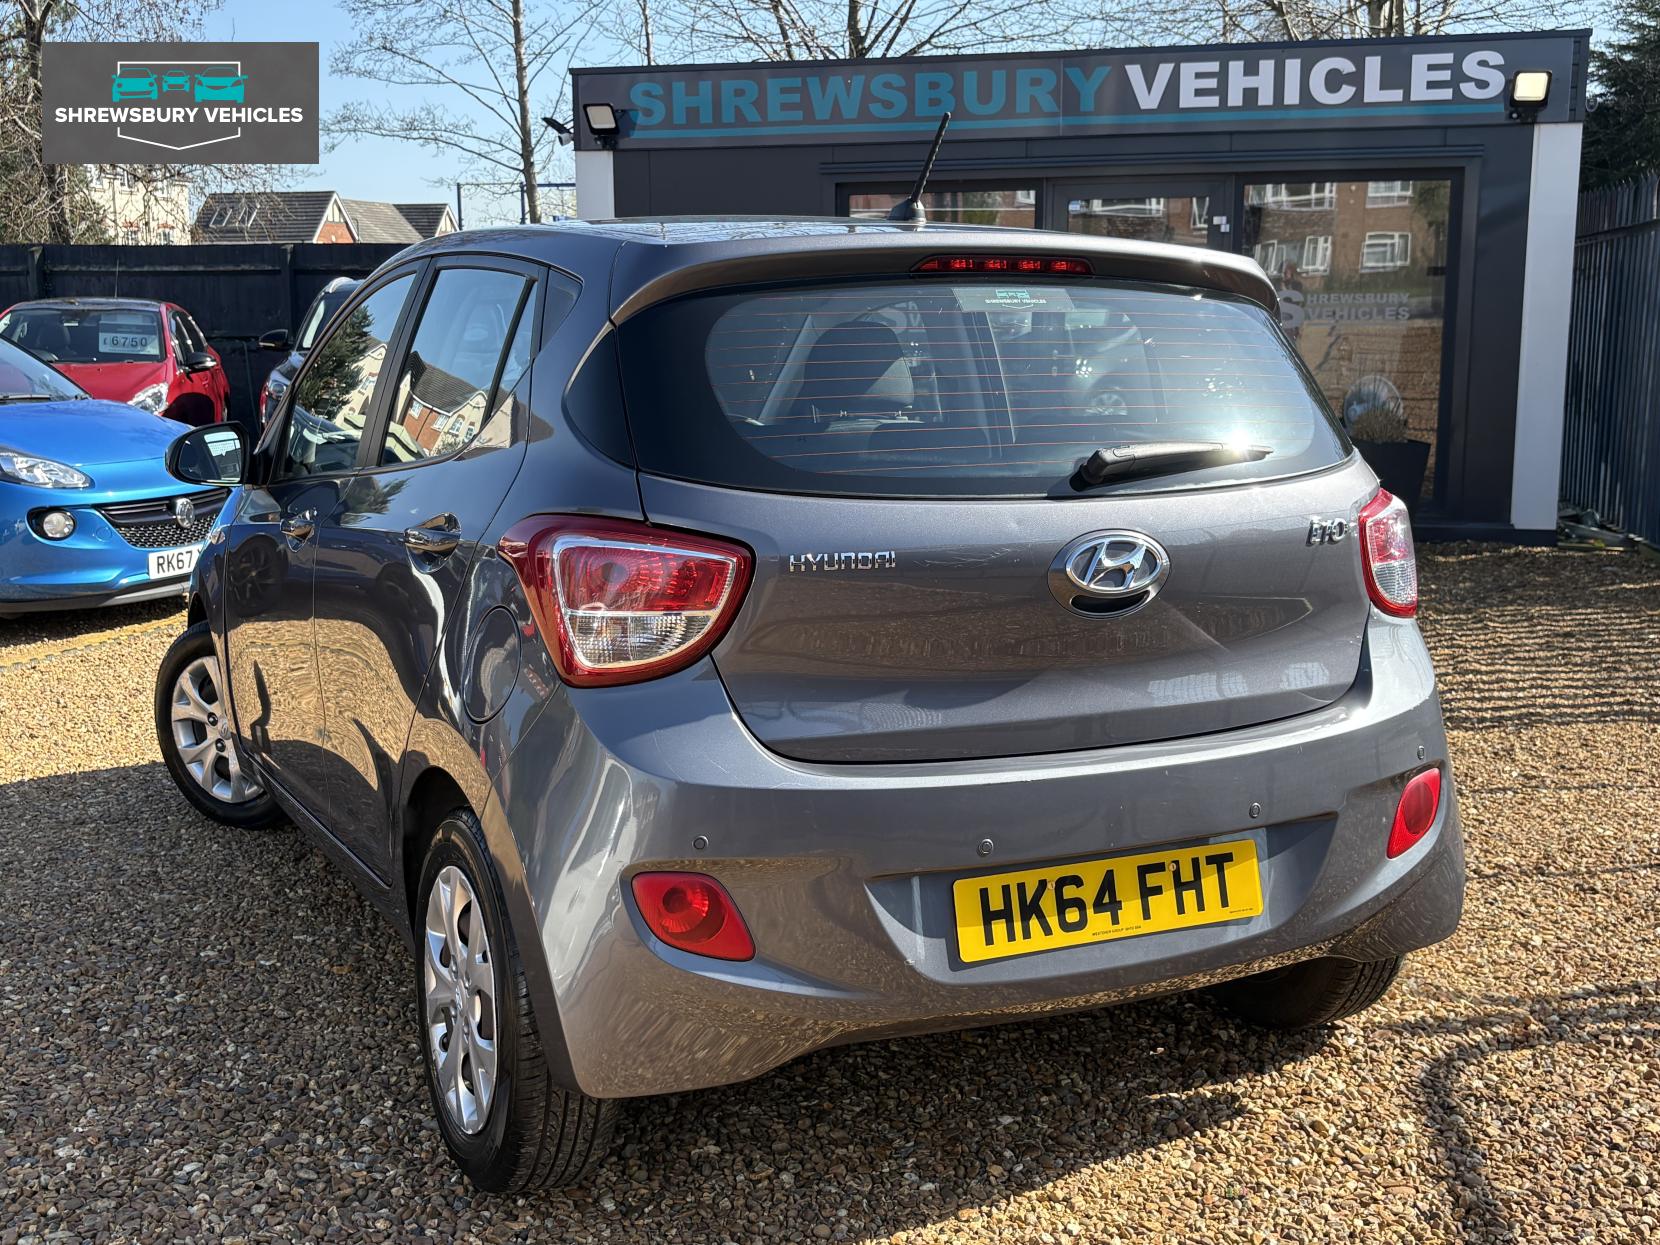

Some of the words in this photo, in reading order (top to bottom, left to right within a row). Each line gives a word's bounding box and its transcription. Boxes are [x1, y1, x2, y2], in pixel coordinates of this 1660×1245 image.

[629, 65, 1112, 127] SHREWSBURY
[1125, 50, 1506, 110] VEHICLES
[1308, 306, 1410, 321] VEHICLES
[156, 550, 193, 574] RK67
[789, 550, 896, 572] HYUNDAI
[979, 869, 1123, 946] HK64
[1136, 852, 1234, 921] FHT
